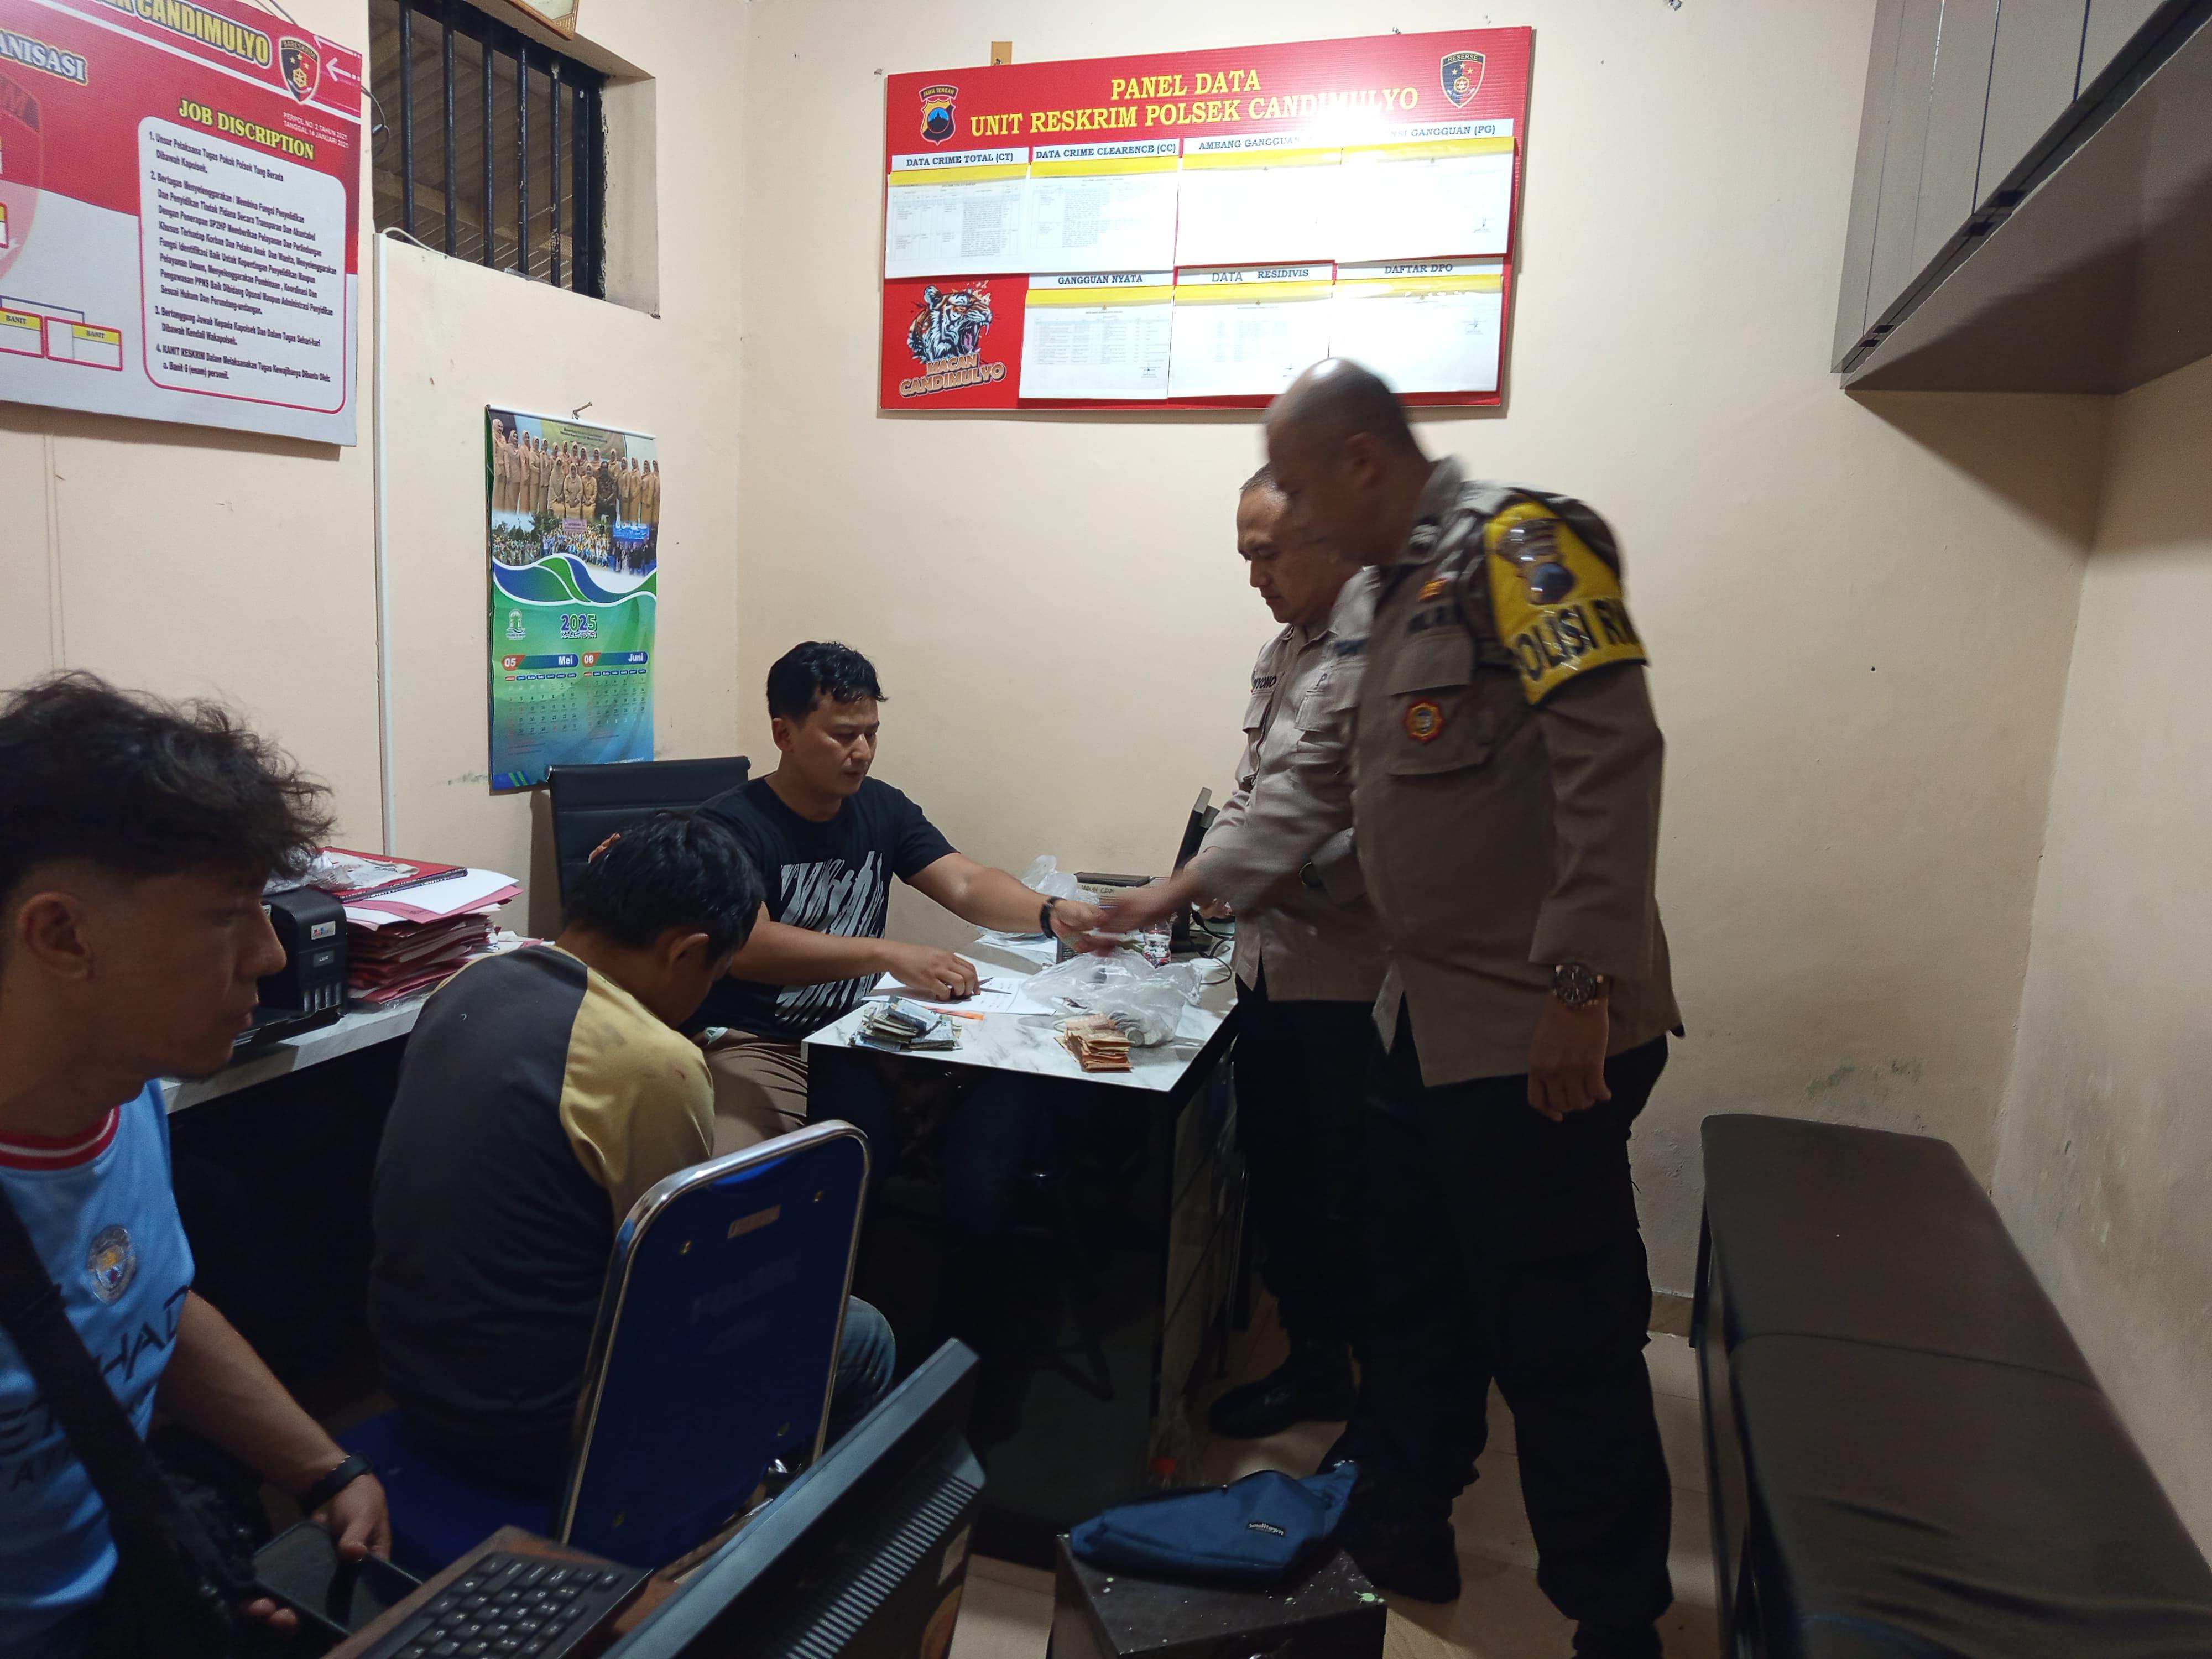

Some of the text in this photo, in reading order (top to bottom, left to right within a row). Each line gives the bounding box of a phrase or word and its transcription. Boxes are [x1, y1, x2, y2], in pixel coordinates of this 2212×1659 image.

[1447, 53, 1479, 62] RESERSE
[1111, 69, 1261, 101] PANEL DATA
[922, 87, 956, 98] JAWA TENGAH
[970, 86, 1419, 137] UNIT RESKRIM POLSEK CANDIMULYO
[178, 98, 315, 160] JOB DISCRIPTION
[1411, 126, 1471, 137] GANGGUAN
[1474, 124, 1496, 135] (PG)
[1035, 143, 1176, 159] DATA CRIME CLEARENCE (CC)
[1199, 139, 1241, 150] AMBANG
[906, 153, 1013, 167] DATA CRIME TOTAL (CT)
[1385, 263, 1453, 274] DAFTAR DPO
[1058, 274, 1143, 284] GANGGUAN NYATA
[1212, 269, 1309, 283] DATA RESIDIVIS
[6, 315, 27, 324] BANIT
[86, 330, 105, 338] BANIT
[927, 353, 978, 375] MACAN
[900, 363, 1006, 397] CANDIMULYO
[560, 613, 597, 632] 2025
[561, 630, 597, 639] KALENDER
[1517, 604, 1599, 681] OLISI
[504, 655, 573, 667] 05 Mei
[628, 653, 644, 662] Juni
